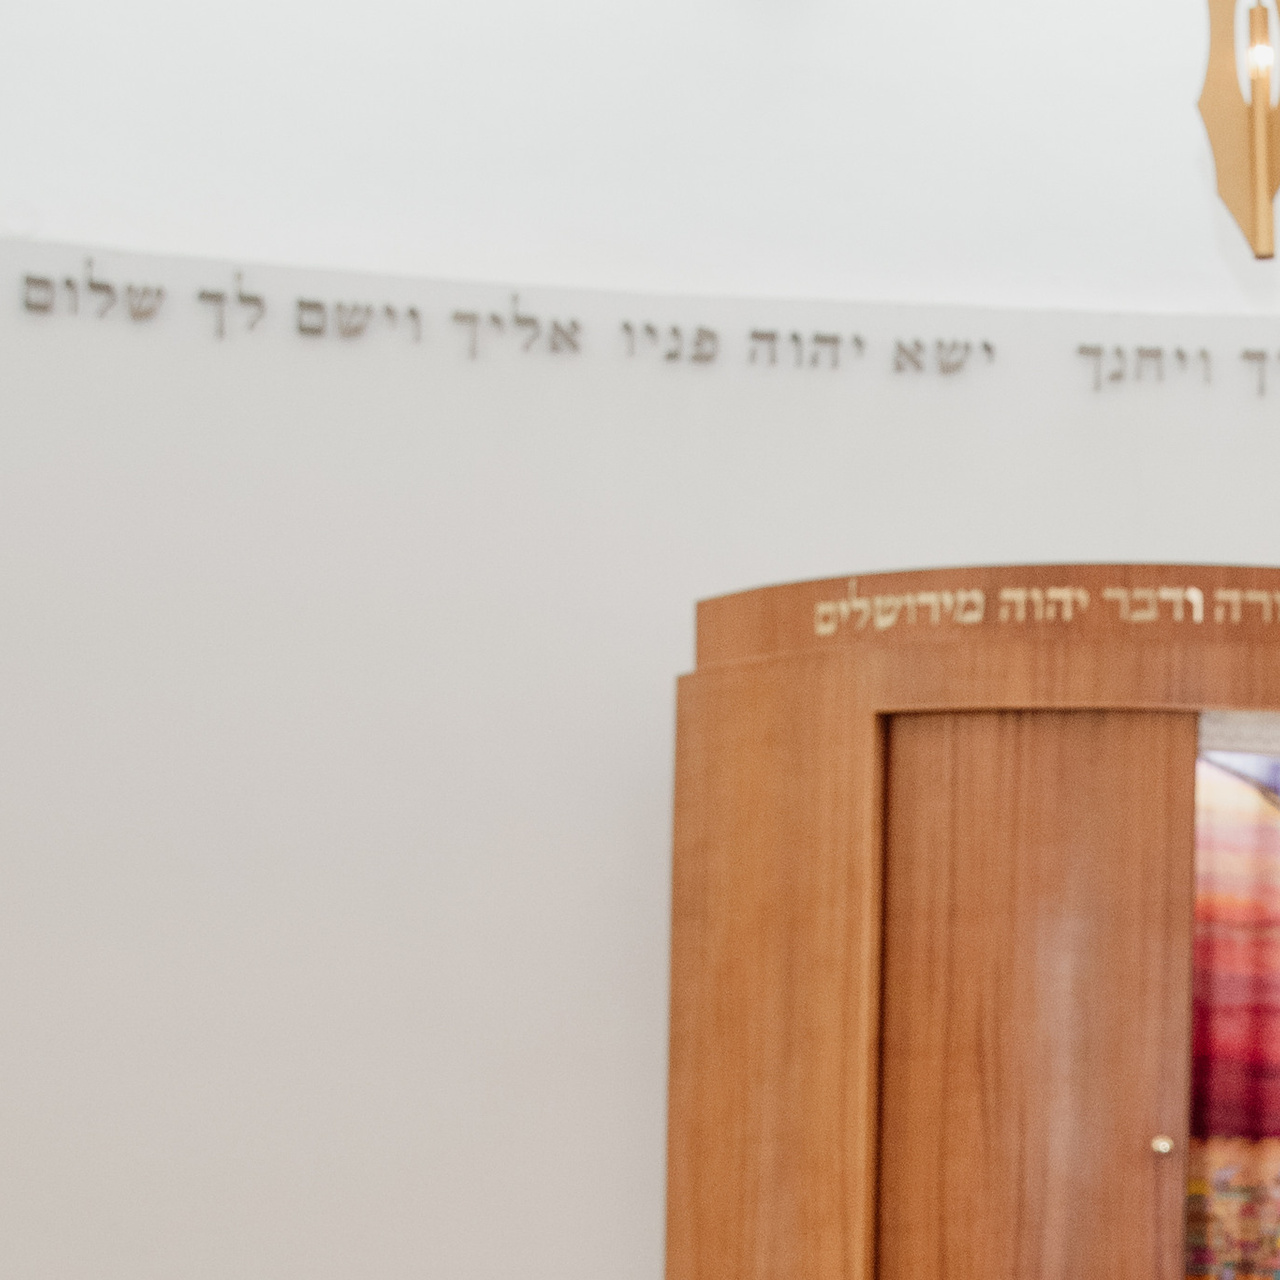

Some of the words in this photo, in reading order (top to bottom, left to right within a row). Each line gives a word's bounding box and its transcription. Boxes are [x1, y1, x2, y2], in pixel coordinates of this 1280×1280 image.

[20, 257, 167, 326] שלום
[197, 270, 268, 341] לך
[294, 296, 423, 343] וישם
[449, 292, 583, 361] אליך
[620, 319, 720, 367] פניו
[746, 327, 867, 371] יהוה
[892, 339, 996, 379] ישא
[1075, 343, 1211, 393] ויחנך
[813, 578, 986, 636] מירושלים
[1000, 586, 1091, 622] יהוה
[1102, 586, 1205, 625] ודבר
